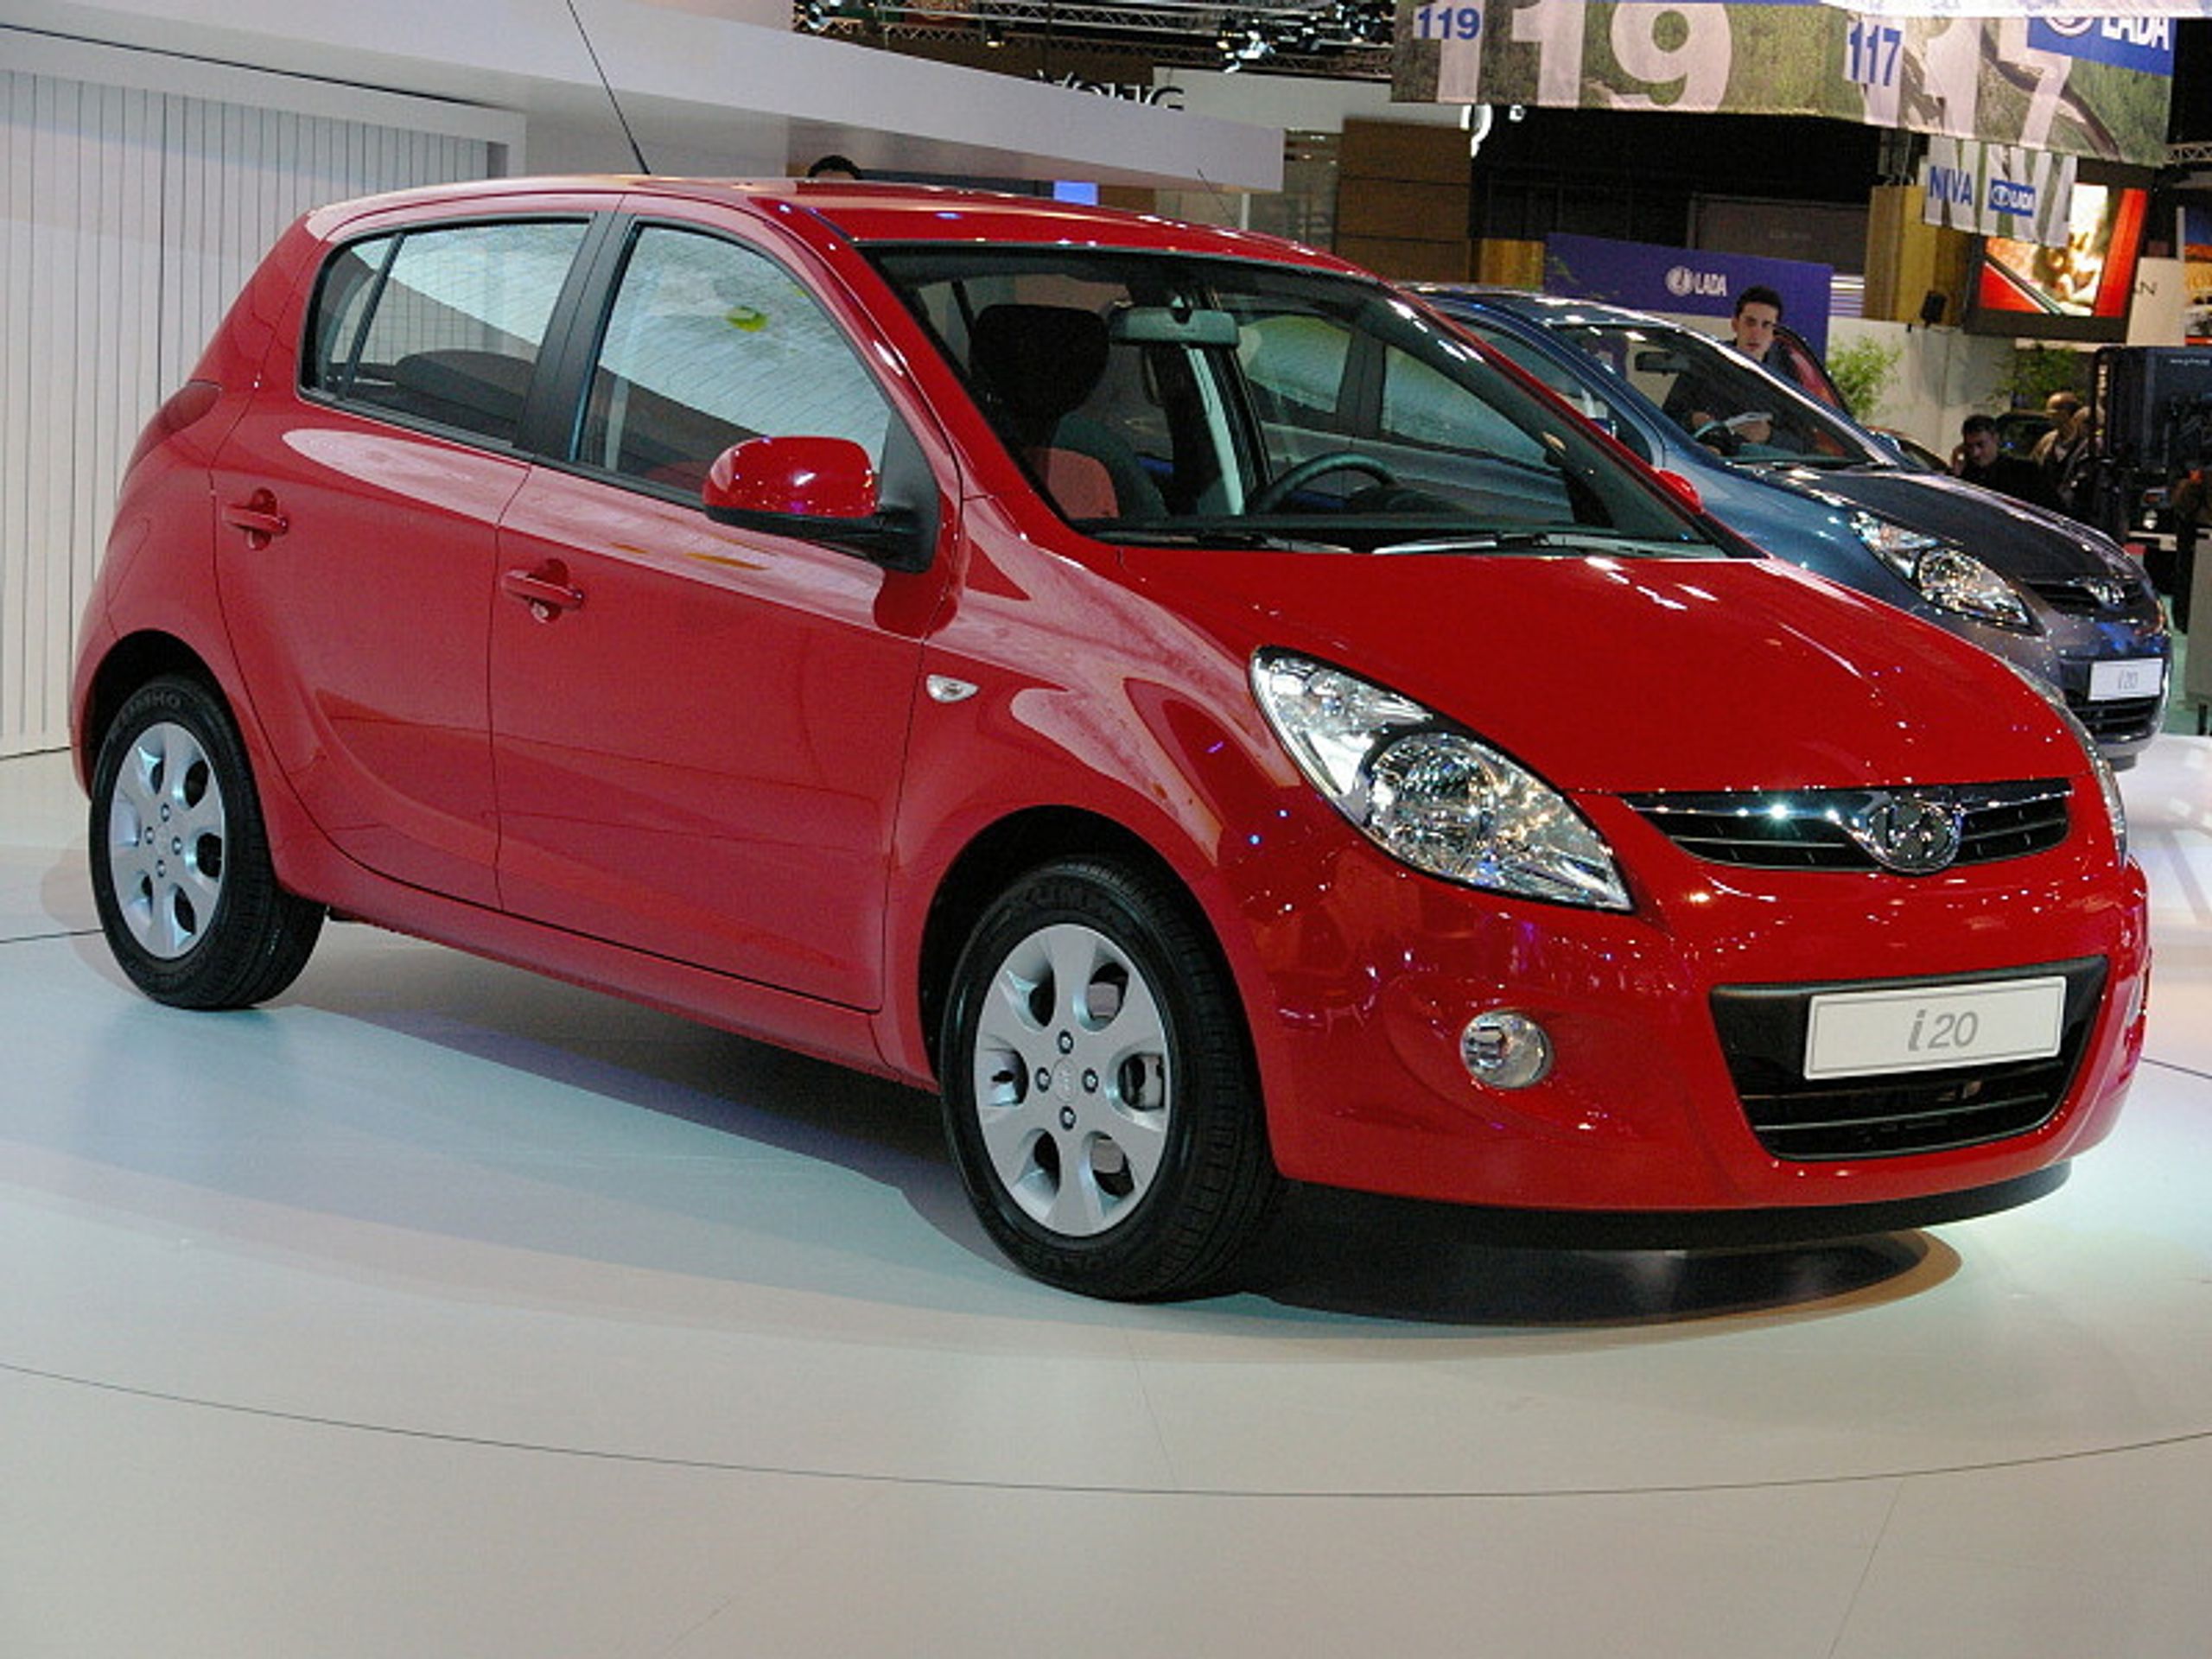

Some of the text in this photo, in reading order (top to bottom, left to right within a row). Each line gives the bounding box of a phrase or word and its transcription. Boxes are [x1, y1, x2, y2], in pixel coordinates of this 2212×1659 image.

[1417, 7, 1481, 40] 119
[1848, 22, 1902, 86] 117
[1694, 271, 1727, 297] LADA
[1907, 1008, 1980, 1052] i20
